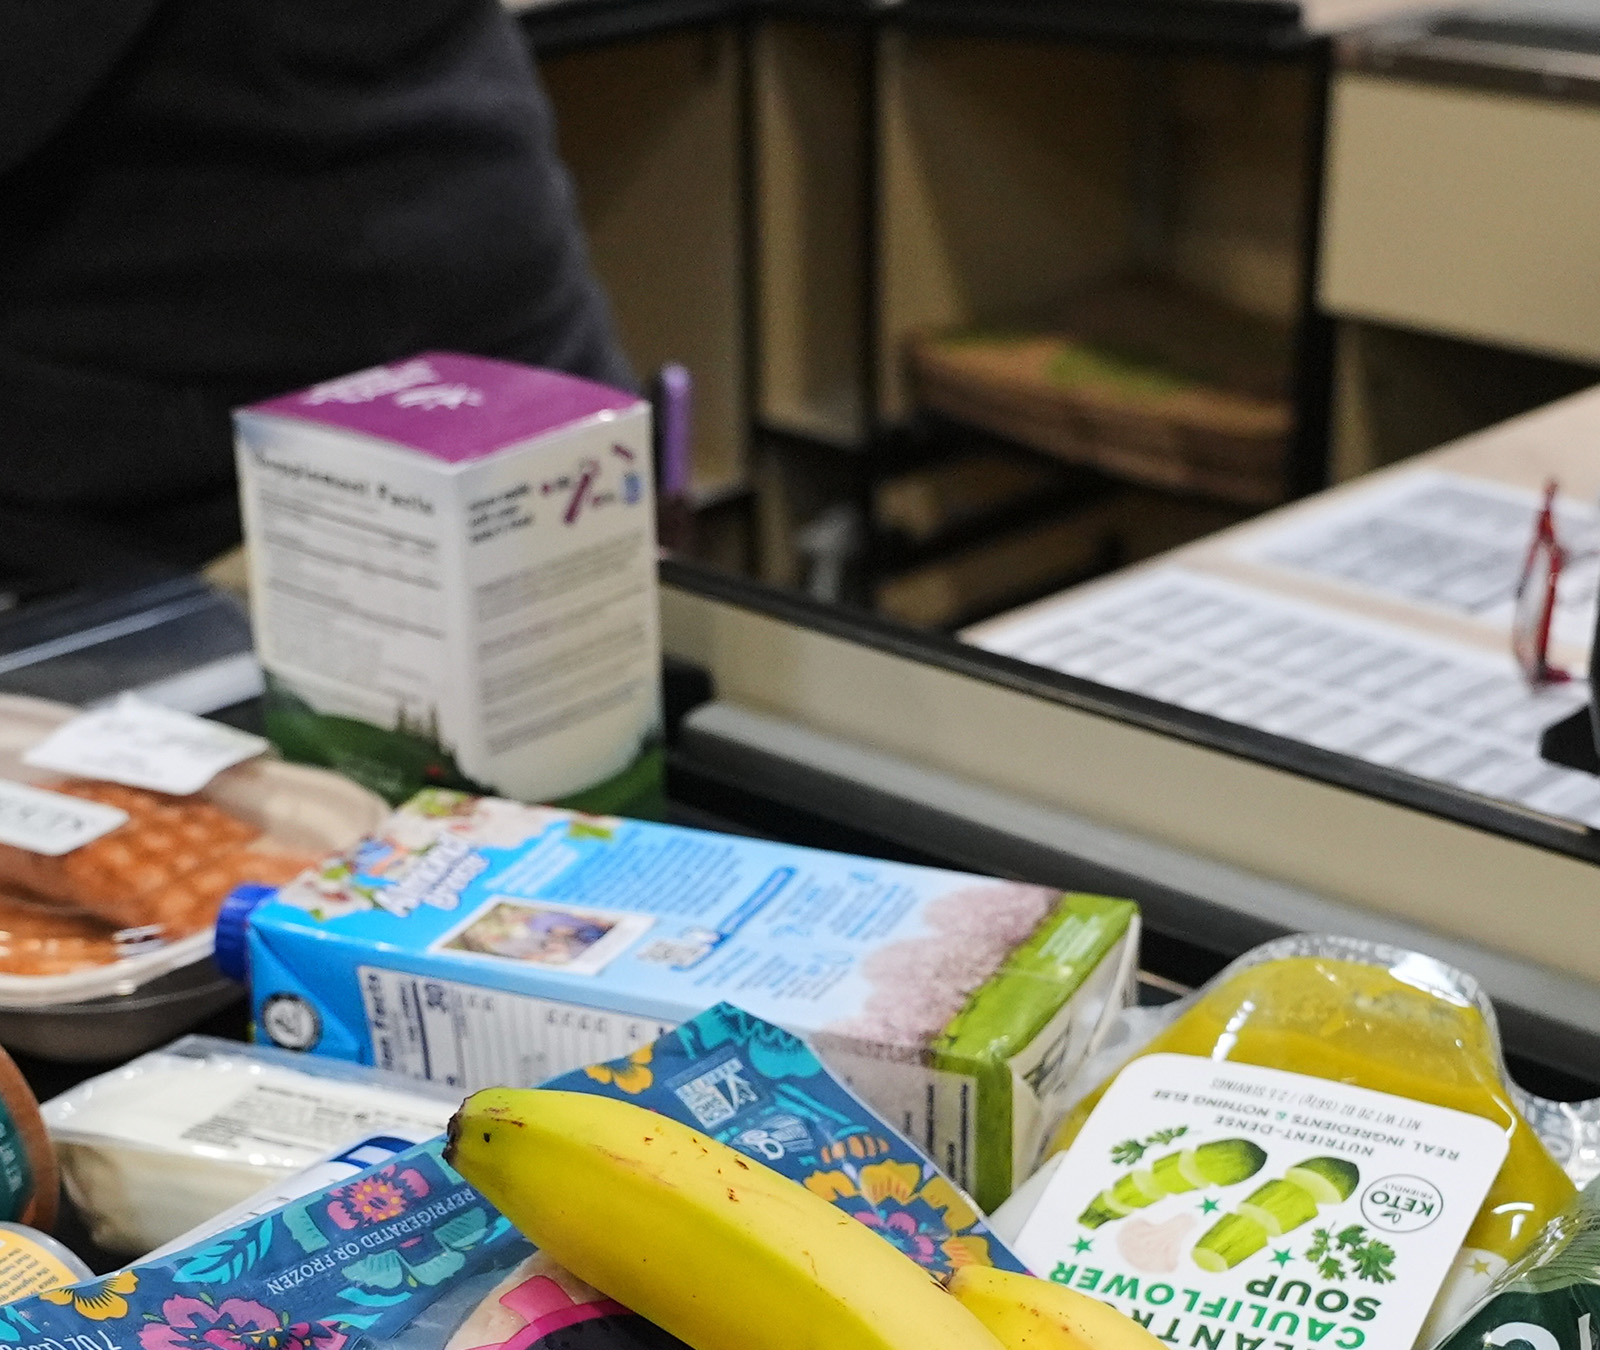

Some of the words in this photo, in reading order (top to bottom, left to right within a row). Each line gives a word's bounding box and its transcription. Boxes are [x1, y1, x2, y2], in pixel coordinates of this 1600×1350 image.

[1152, 1088, 1184, 1100] ELSE
[1193, 1094, 1269, 1117] NOTHING
[1275, 1110, 1287, 1121] &
[1214, 1115, 1374, 1156] NUTRIENT-DENSE
[1292, 1115, 1405, 1146] INGREDIENTS
[1412, 1140, 1460, 1161] REAL
[1370, 1190, 1435, 1217] KETO
[1382, 1182, 1434, 1200] FRIENDLY
[359, 1189, 476, 1249] REFRIGERATED
[336, 1244, 359, 1262] OR
[267, 1253, 334, 1296] FROZEN
[1049, 1260, 1367, 1350] CAULIFLOWER
[1246, 1273, 1383, 1322] SOUP
